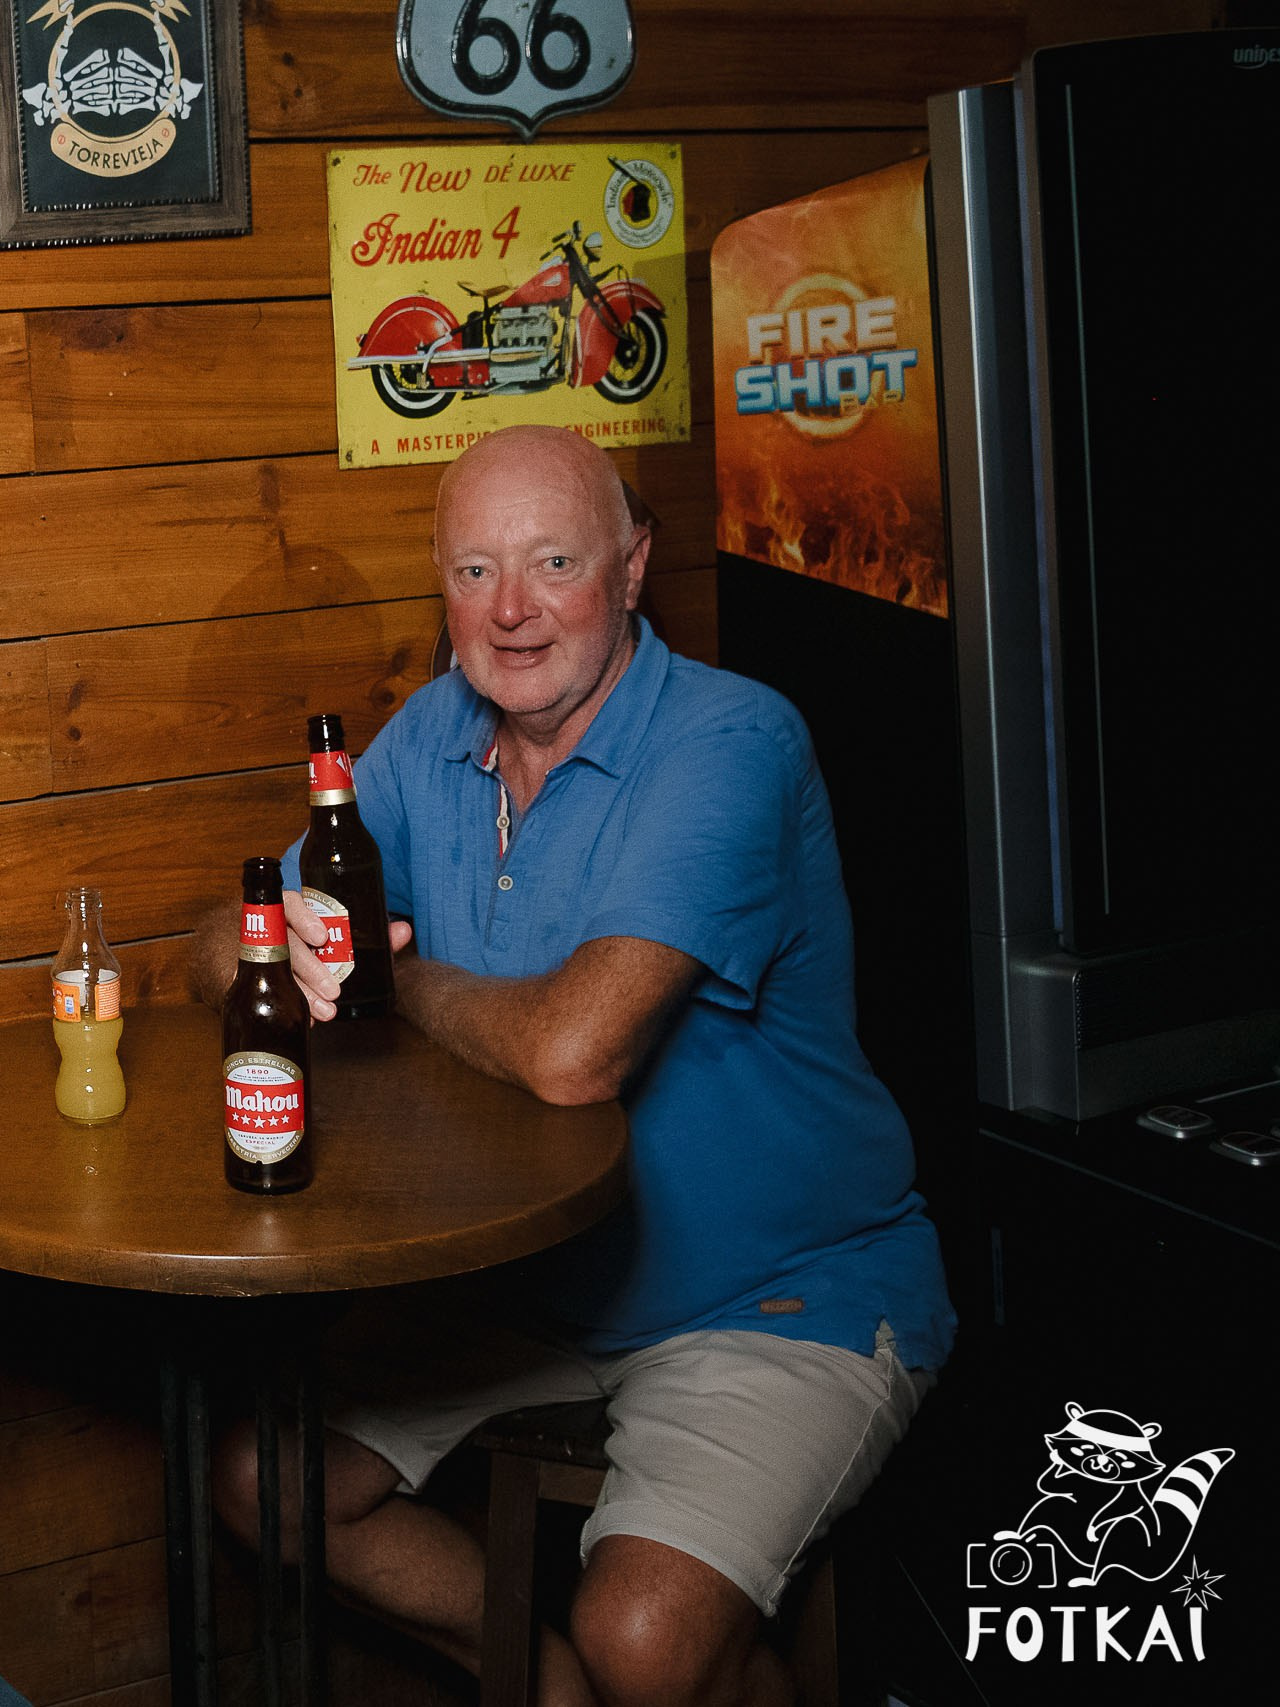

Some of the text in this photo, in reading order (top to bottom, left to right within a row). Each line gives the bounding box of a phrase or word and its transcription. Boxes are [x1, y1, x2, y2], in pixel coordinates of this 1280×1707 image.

[452, 0, 590, 95] 66
[69, 138, 163, 169] TORREVIEJA
[353, 164, 391, 186] The
[399, 161, 470, 193] New
[519, 163, 577, 182] LUXE
[351, 206, 521, 267] Indian 4
[746, 296, 897, 364] FIRE
[735, 349, 918, 415] SHOT
[371, 440, 380, 454] A
[248, 1057, 296, 1075] ESTRELLAS
[225, 1085, 300, 1112] Mahou
